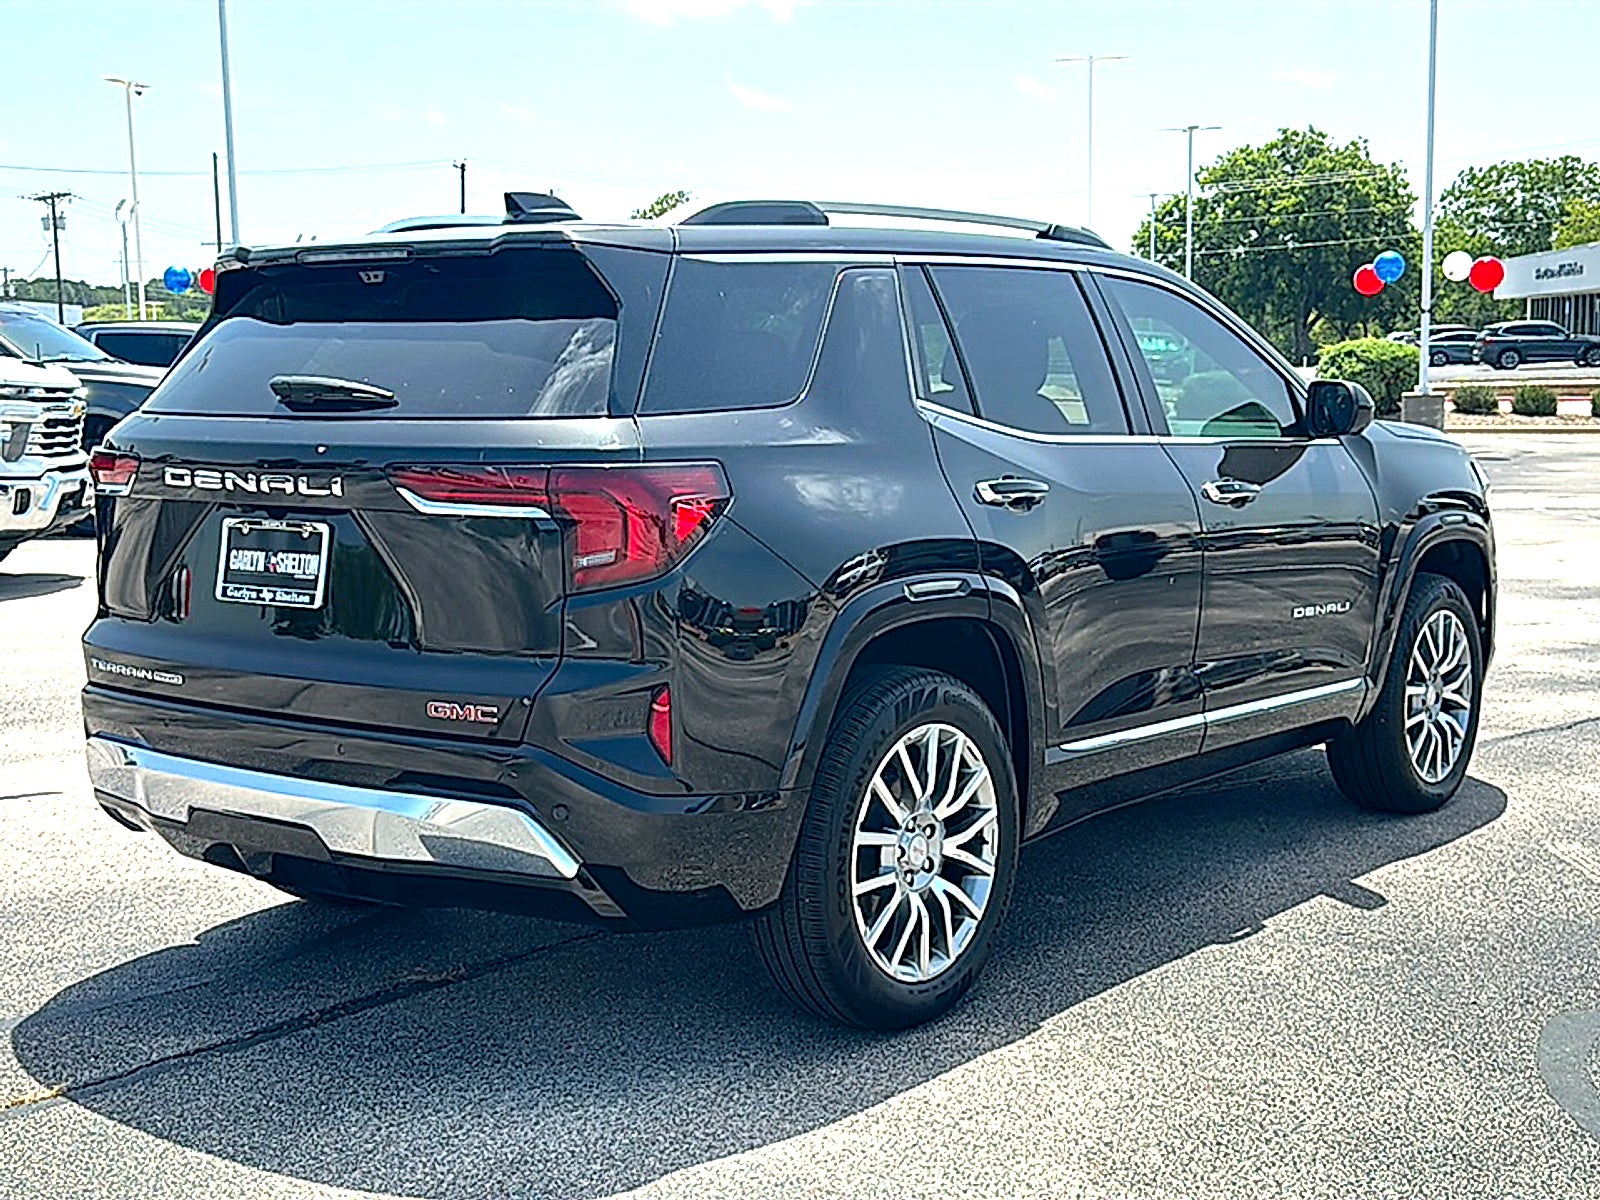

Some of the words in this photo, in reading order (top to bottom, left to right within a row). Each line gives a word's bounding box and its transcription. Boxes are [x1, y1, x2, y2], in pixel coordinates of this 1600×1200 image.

[164, 466, 343, 497] DENALI
[229, 549, 266, 572] GARLYN
[277, 552, 320, 575] SHELTON
[275, 591, 310, 603] Shelton
[1293, 601, 1350, 618] DENALI
[91, 657, 153, 680] TERRAIN
[426, 701, 498, 723] GMC
